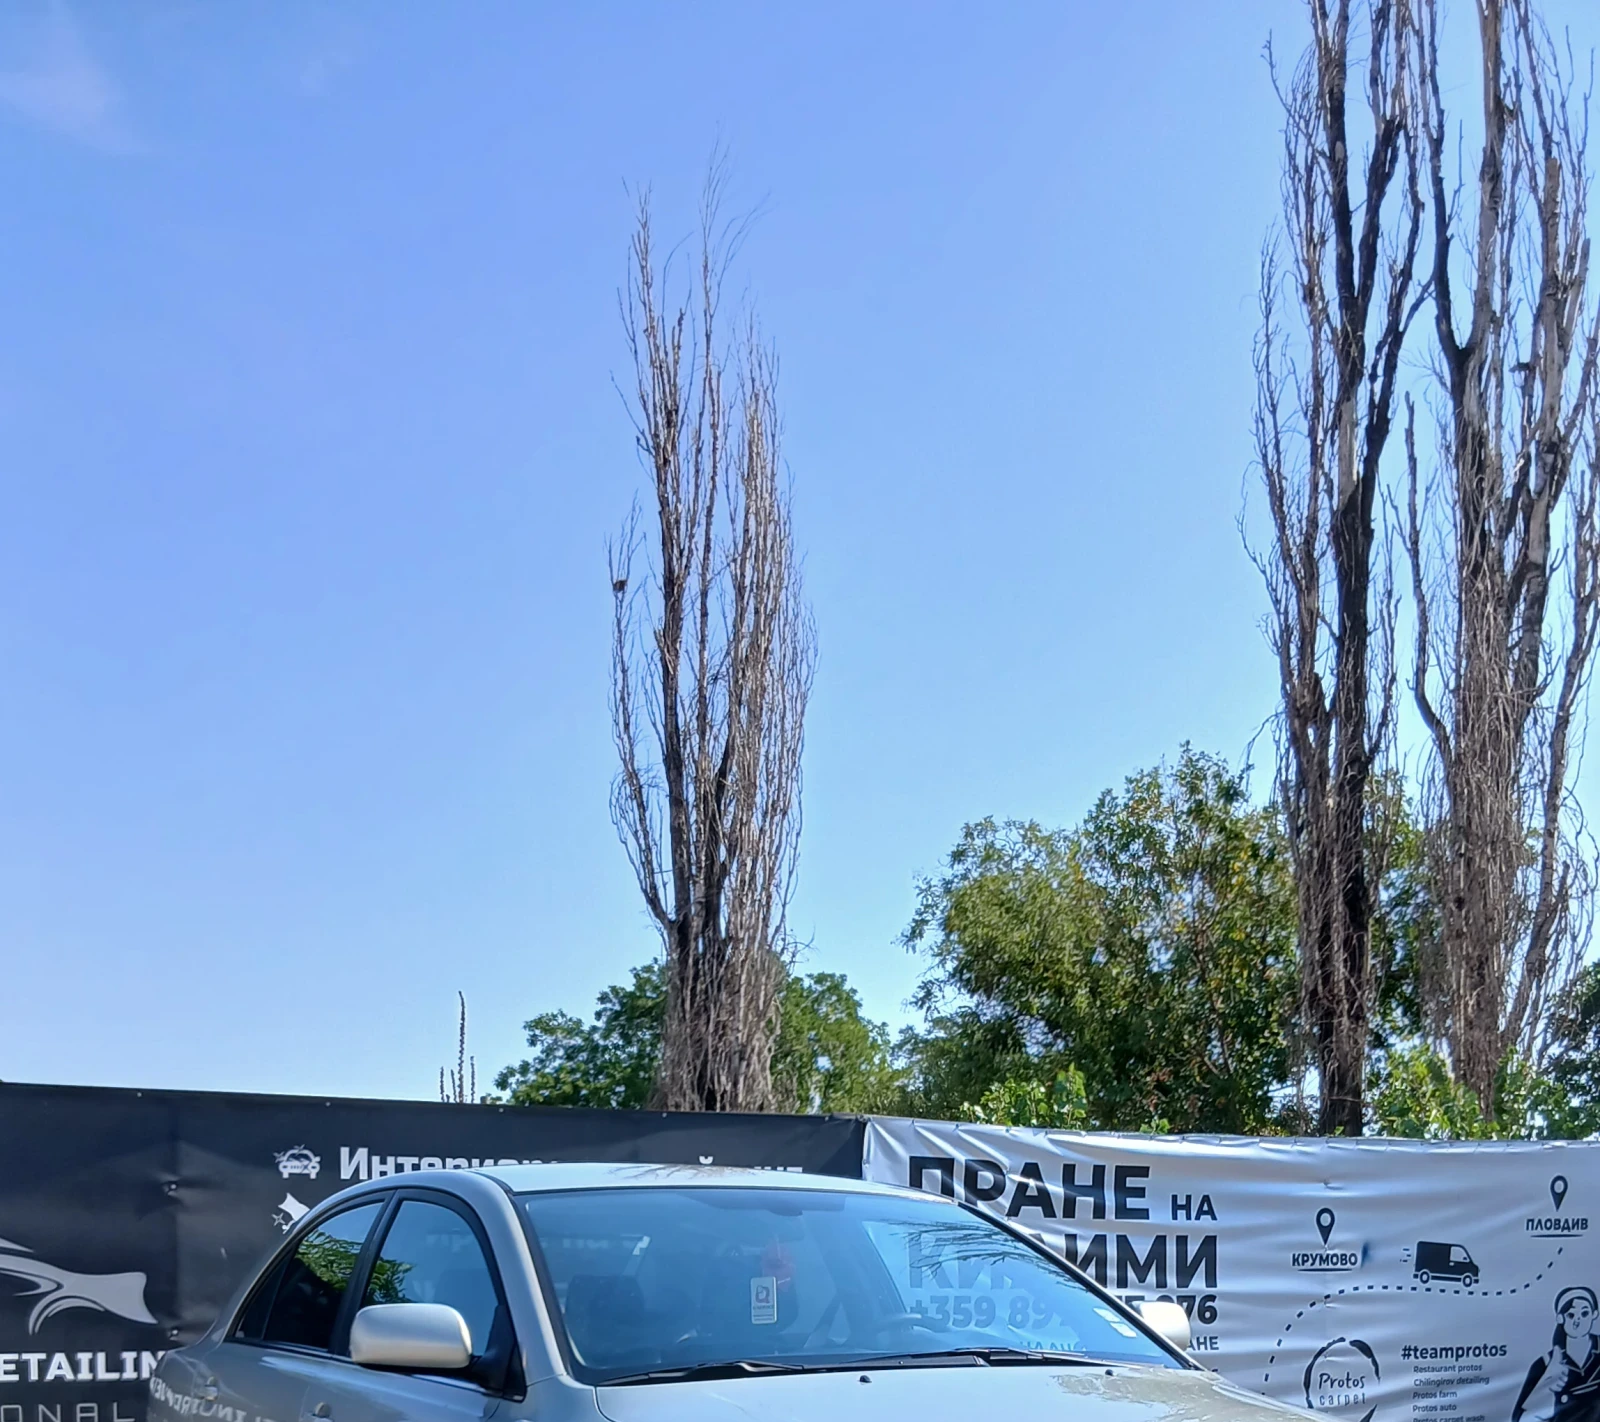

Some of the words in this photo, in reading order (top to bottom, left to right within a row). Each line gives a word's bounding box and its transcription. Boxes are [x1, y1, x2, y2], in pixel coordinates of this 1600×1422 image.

[908, 1155, 1150, 1220] ПРАНЕ
[1170, 1194, 1218, 1221] НА
[1525, 1217, 1589, 1232] ПЛОВДИВ
[1291, 1252, 1358, 1268] КРУМОВО
[1401, 1343, 1508, 1362] #teamprotos
[1413, 1364, 1456, 1374] Restaurant
[1457, 1363, 1483, 1374] protos
[1319, 1371, 1366, 1391] Protos
[1413, 1377, 1455, 1388] Chilingirov
[1456, 1375, 1490, 1386] detailing
[1319, 1393, 1366, 1406] carpet
[1412, 1391, 1438, 1400] Protos
[1439, 1390, 1458, 1399] farm
[1412, 1404, 1438, 1413] Protos
[1439, 1403, 1457, 1412] auto
[1465, 1414, 1486, 1422] wash
